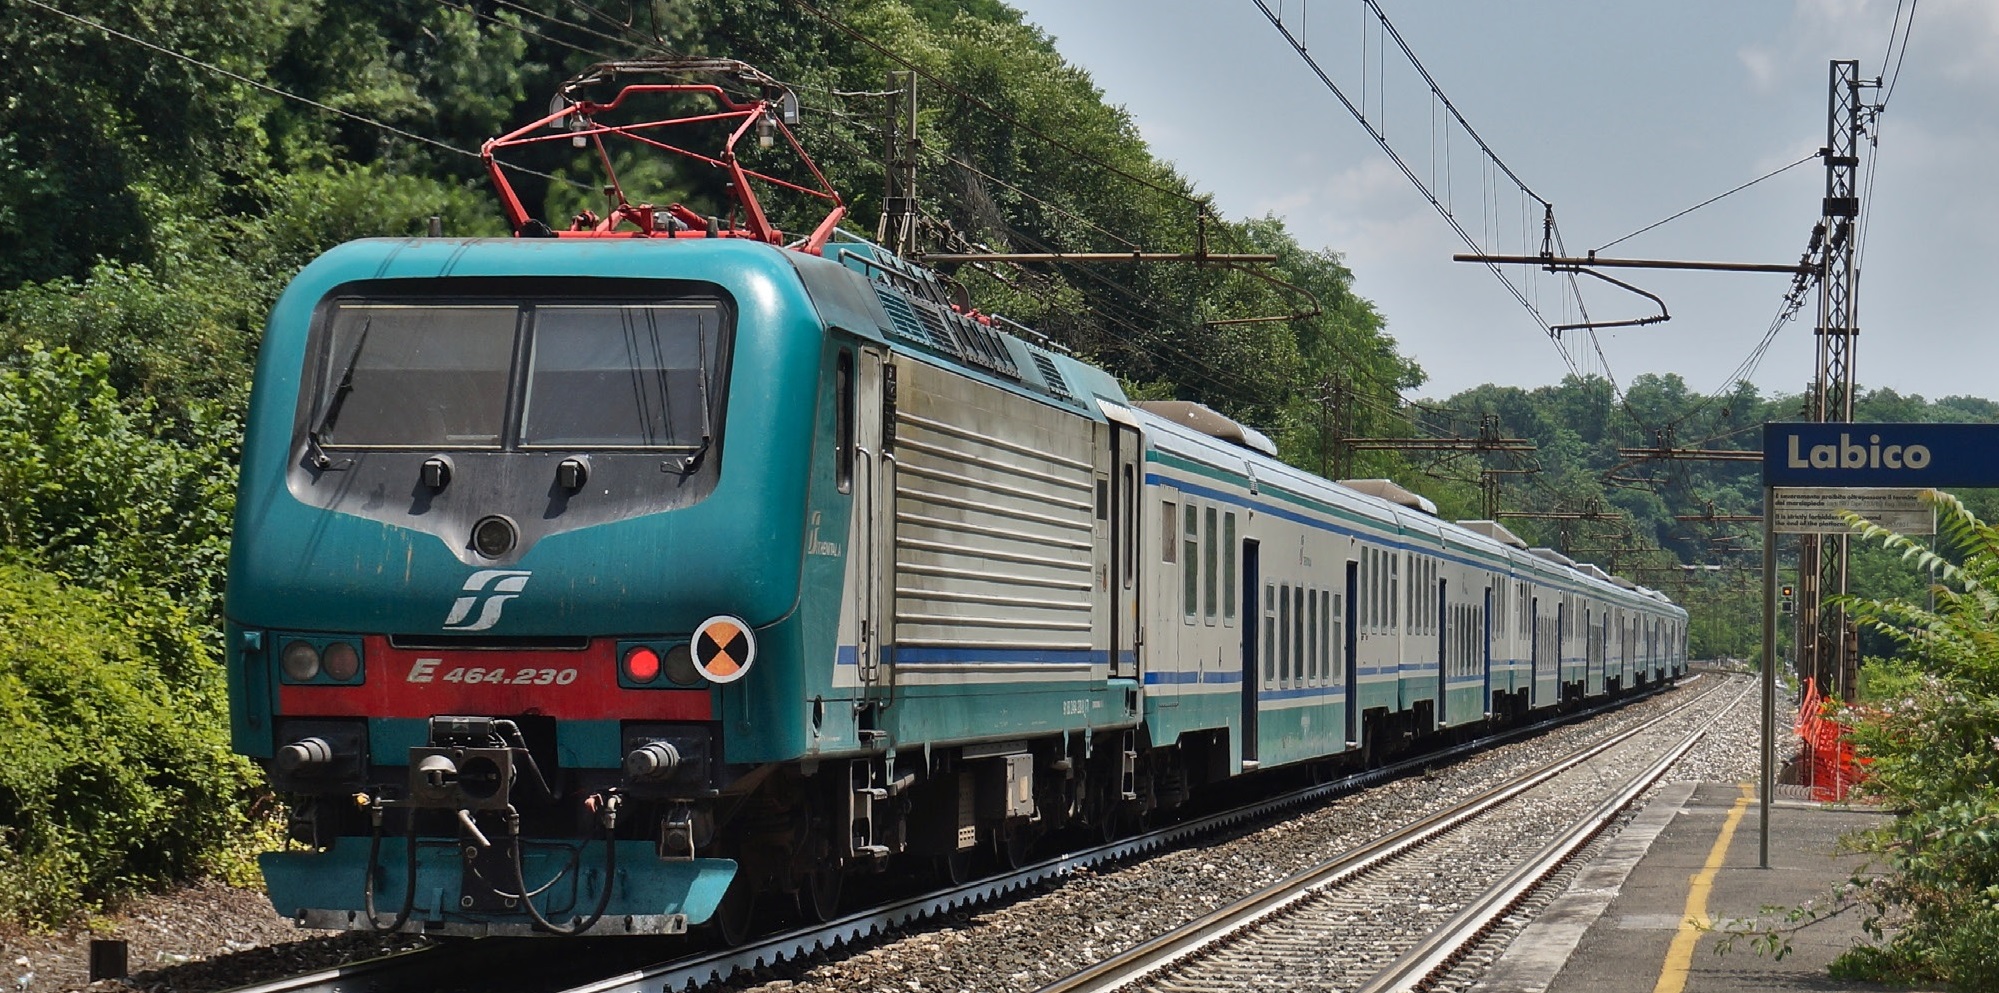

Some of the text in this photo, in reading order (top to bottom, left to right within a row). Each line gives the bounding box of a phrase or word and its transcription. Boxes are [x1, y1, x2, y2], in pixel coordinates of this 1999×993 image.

[1787, 433, 1931, 469] Labico
[406, 658, 578, 686] E 464.230
